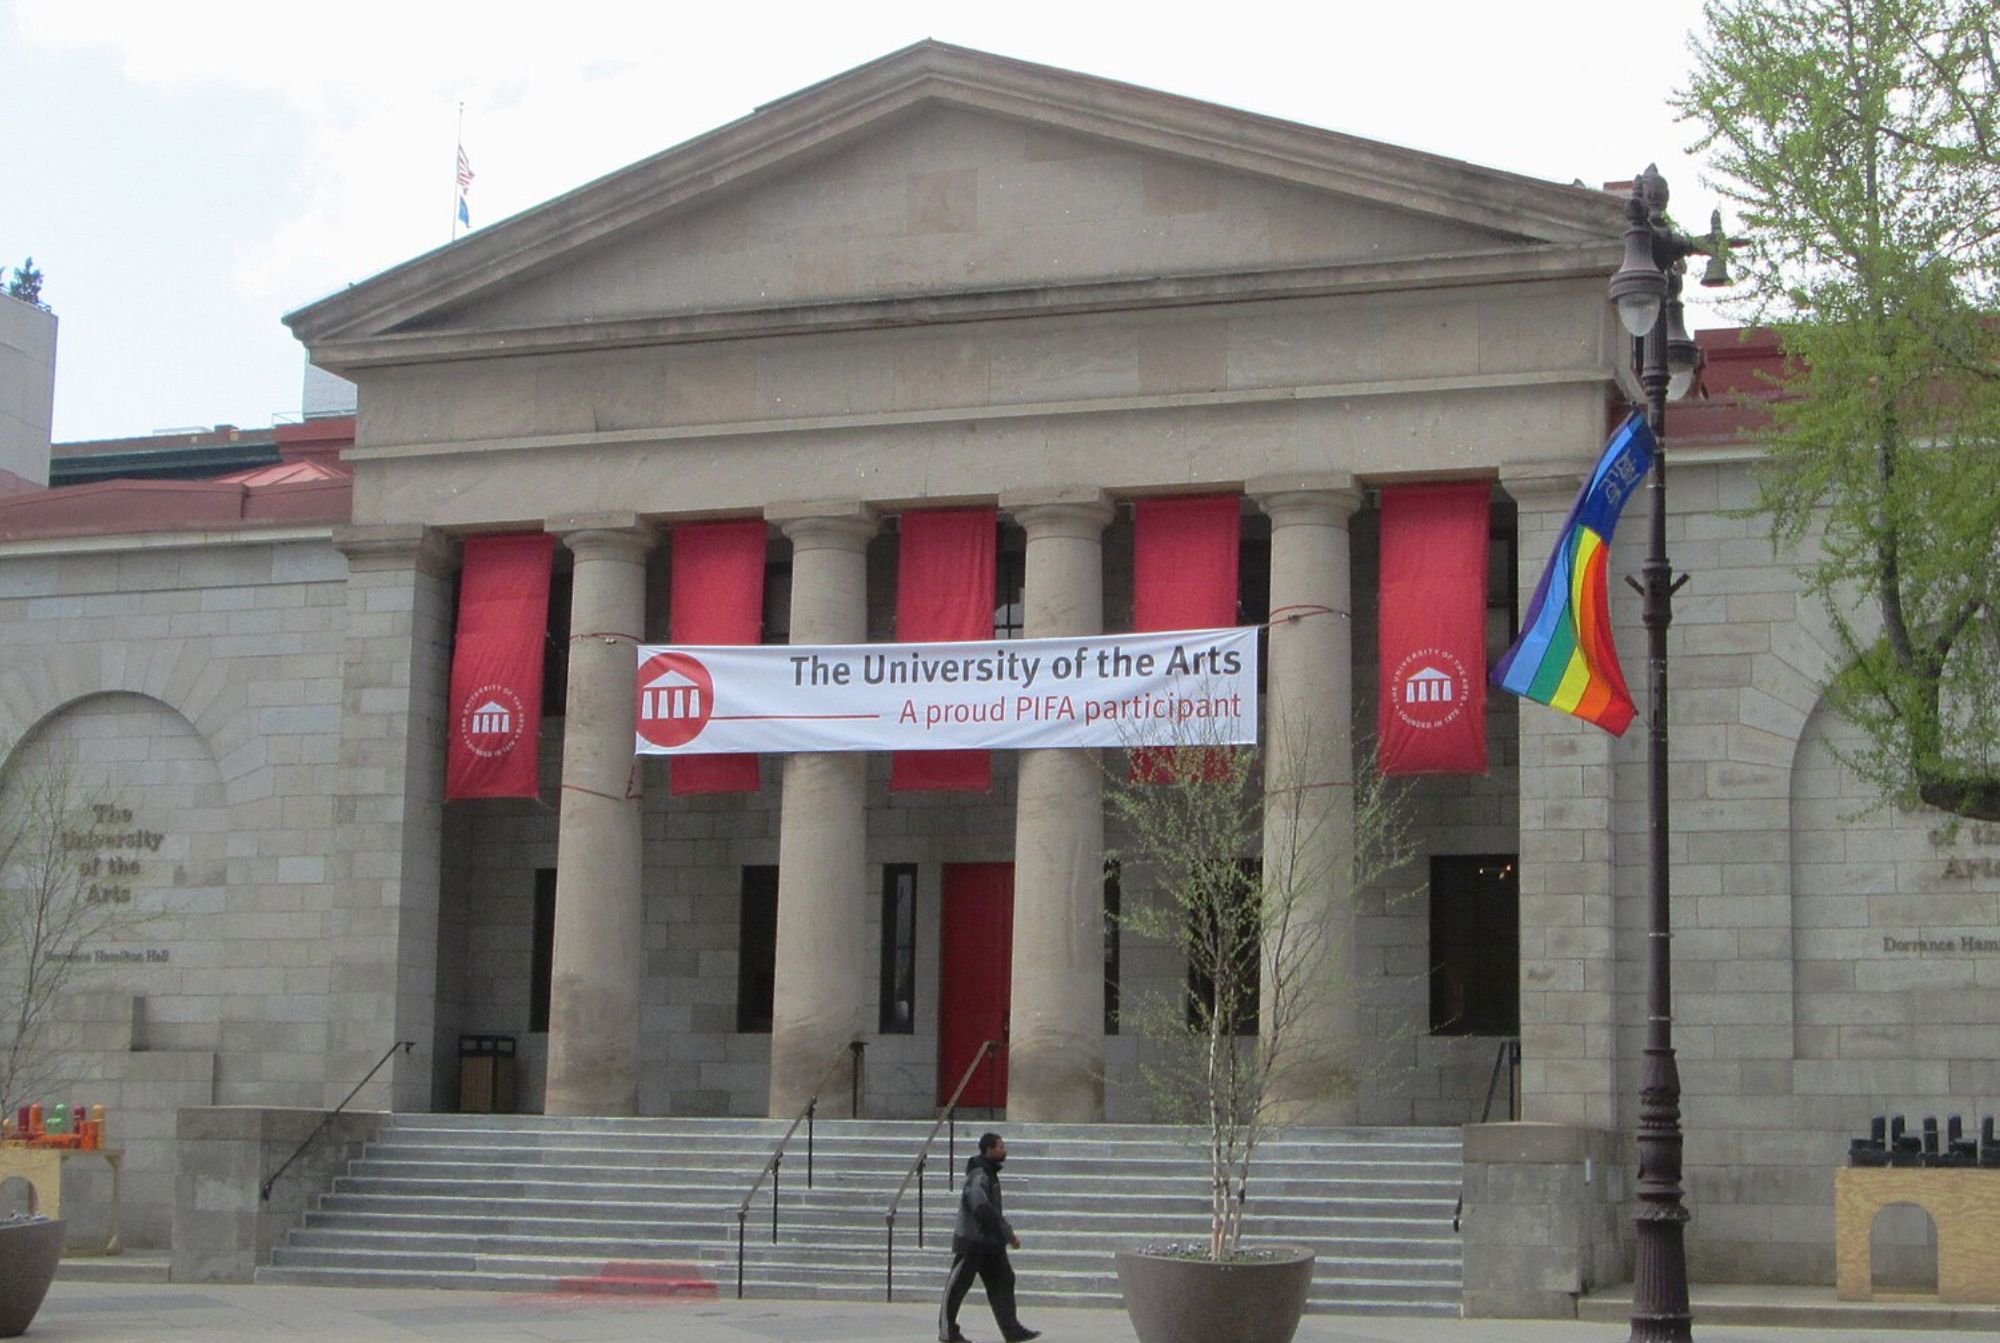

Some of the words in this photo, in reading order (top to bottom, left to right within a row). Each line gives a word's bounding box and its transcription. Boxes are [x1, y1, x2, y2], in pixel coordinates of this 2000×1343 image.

[790, 655, 850, 687] The
[862, 650, 1042, 690] University
[1051, 646, 1089, 681] of
[1095, 646, 1155, 680] the
[1166, 644, 1242, 677] Arts
[898, 699, 918, 726] A
[925, 695, 1007, 731] proud
[1016, 694, 1076, 722] PIFA
[1085, 691, 1242, 730] participant
[93, 803, 132, 824] The
[108, 856, 140, 876] the
[87, 883, 131, 903] Arts
[1883, 936, 1955, 952] Dorrance
[146, 948, 171, 963] Hall
